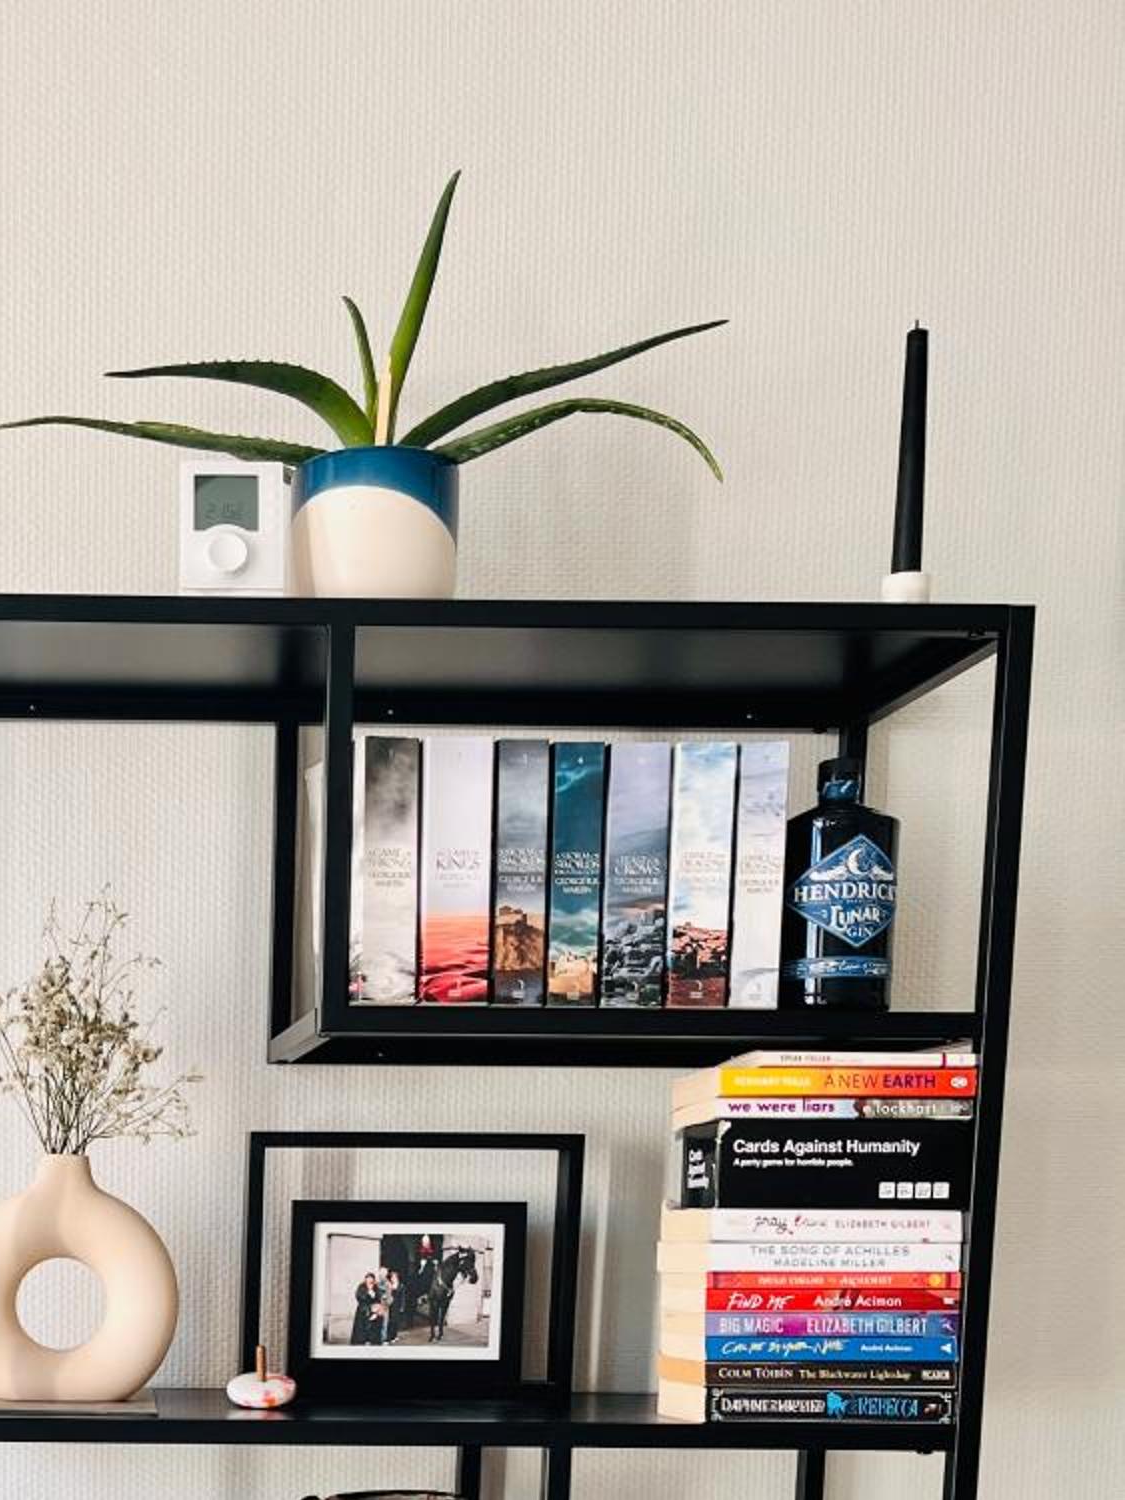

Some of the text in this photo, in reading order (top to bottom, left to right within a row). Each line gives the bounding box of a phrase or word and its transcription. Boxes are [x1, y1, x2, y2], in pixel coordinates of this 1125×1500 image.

[829, 905, 881, 931] LUNAR
[846, 926, 873, 937] GIN
[824, 1074, 835, 1089] A
[839, 1074, 877, 1089] NEW
[882, 1075, 936, 1089] EARTH
[728, 1098, 835, 1113] we were liars
[733, 1139, 920, 1156] Cards Against Humanity
[834, 1219, 888, 1230] ELIZABETH
[890, 1219, 931, 1230] GILBERT
[750, 1245, 911, 1257] THE SONG OF ACHILLES
[774, 1258, 886, 1268] MADELINE MILLER
[727, 1292, 763, 1311] FIND
[766, 1294, 796, 1311] ME
[856, 1296, 902, 1308] Aciman
[720, 1316, 927, 1334] BIG MAGIC ELIZABETH GILBERT
[718, 1367, 751, 1378] COLM
